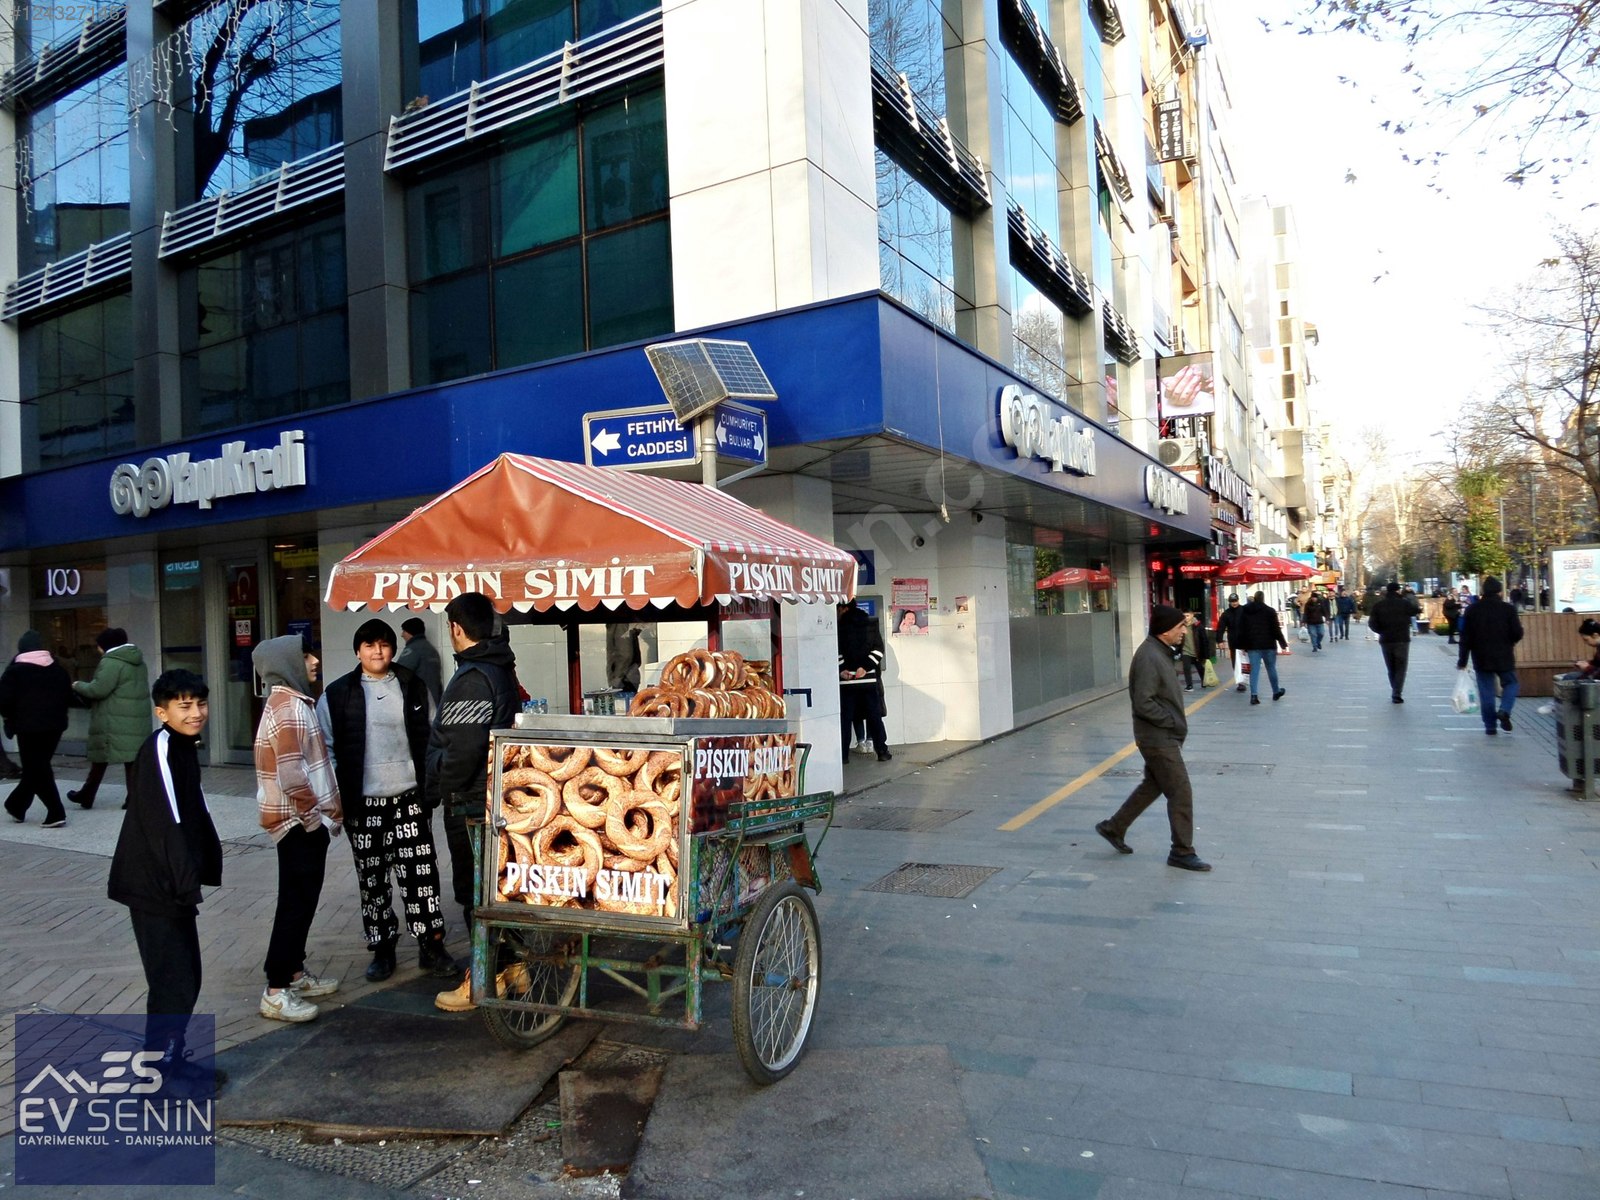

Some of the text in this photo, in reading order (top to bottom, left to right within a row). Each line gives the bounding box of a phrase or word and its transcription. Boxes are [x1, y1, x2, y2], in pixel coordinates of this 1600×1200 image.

[627, 417, 684, 436] FETHİYE
[721, 413, 757, 432] CUMHURİYET
[627, 437, 687, 457] CADDESİ
[729, 435, 752, 450] BULVARI
[371, 557, 655, 608] PİŞKİN SİMİT
[728, 554, 844, 597] PİŞKİN SİMİT
[695, 741, 750, 786] PİŞKİN
[504, 856, 671, 905] PİŞKİN SİMİT
